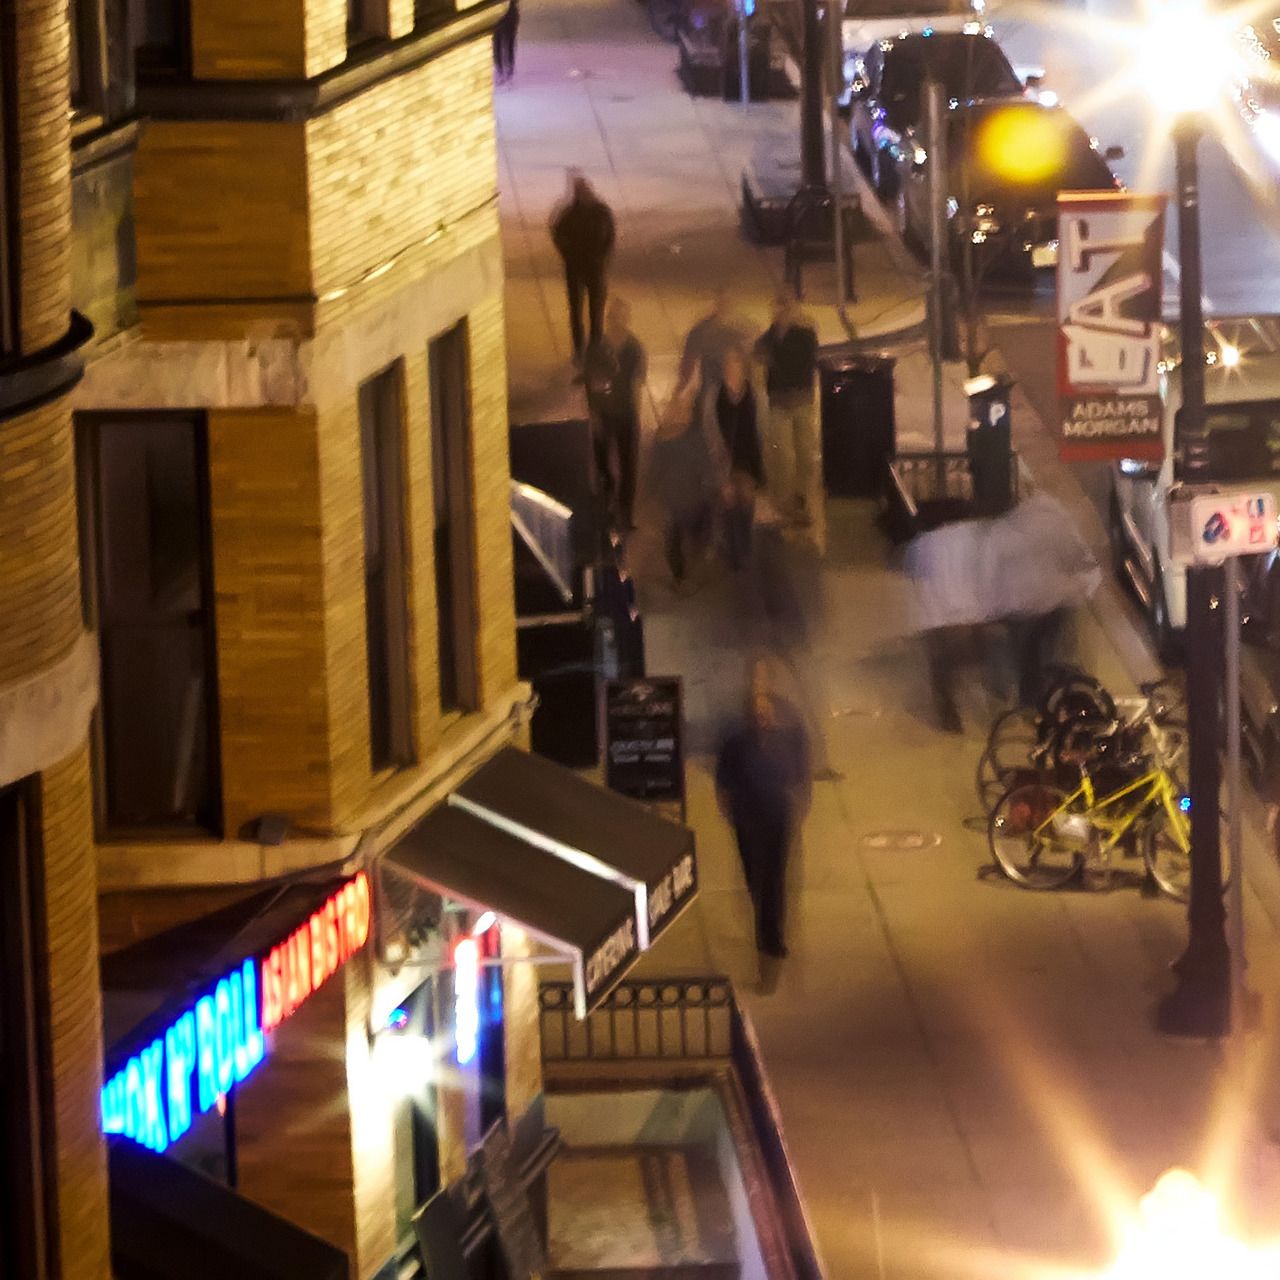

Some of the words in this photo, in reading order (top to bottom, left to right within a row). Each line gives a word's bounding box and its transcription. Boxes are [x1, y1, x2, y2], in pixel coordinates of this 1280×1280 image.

[1068, 219, 1151, 385] EAT
[1062, 417, 1159, 439] MORGAN
[1072, 399, 1150, 420] ADAMS
[261, 923, 312, 1033] ASIAN
[309, 870, 370, 991] BISTRO
[101, 1038, 168, 1154] WOK
[195, 957, 265, 1114] ROLL
